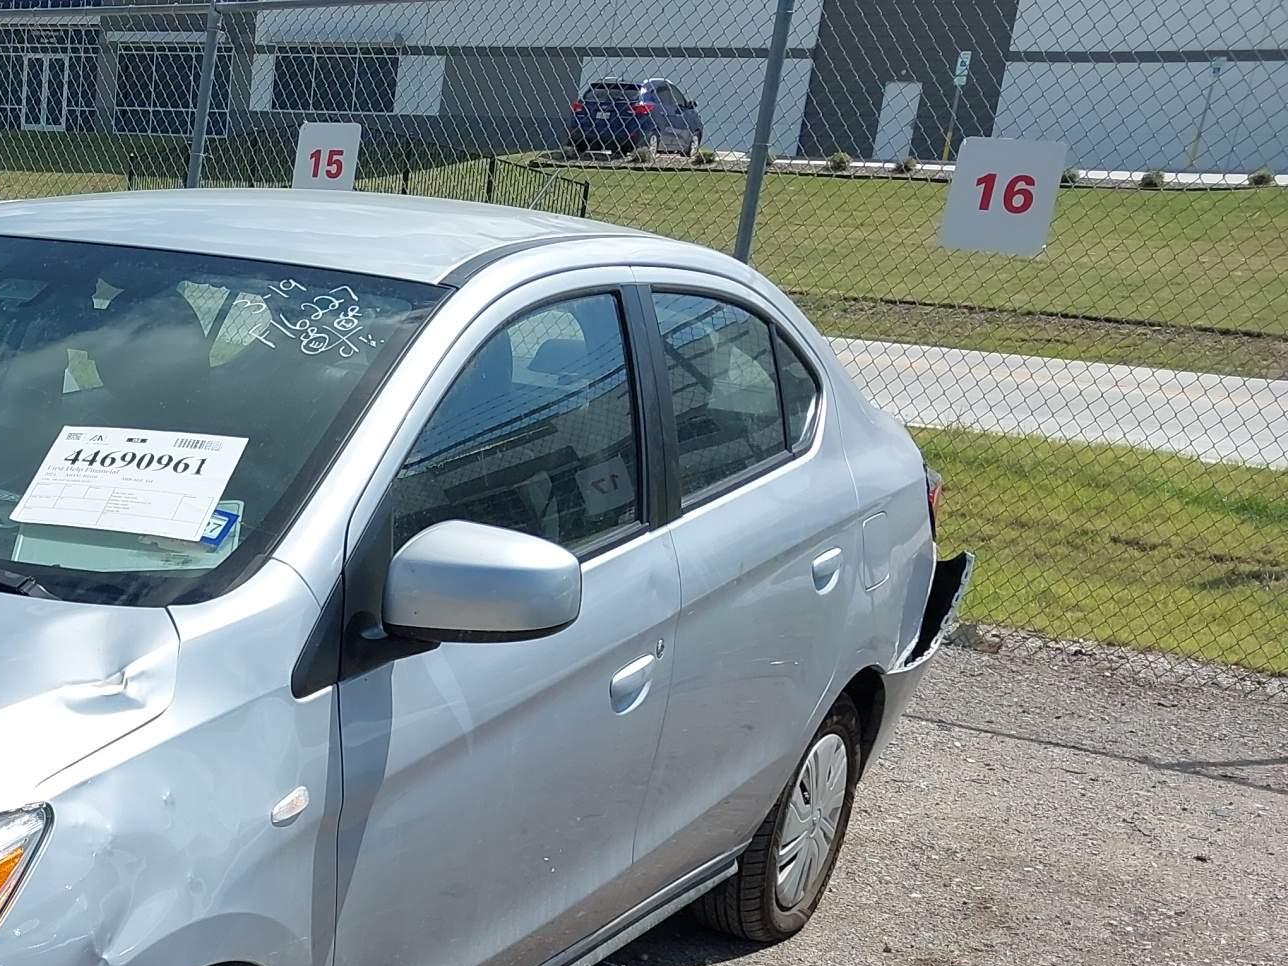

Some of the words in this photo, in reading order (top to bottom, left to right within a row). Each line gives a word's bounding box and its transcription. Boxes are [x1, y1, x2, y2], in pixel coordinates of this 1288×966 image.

[309, 148, 344, 179] 15
[975, 173, 1037, 215] 16
[63, 448, 209, 476] 44690961
